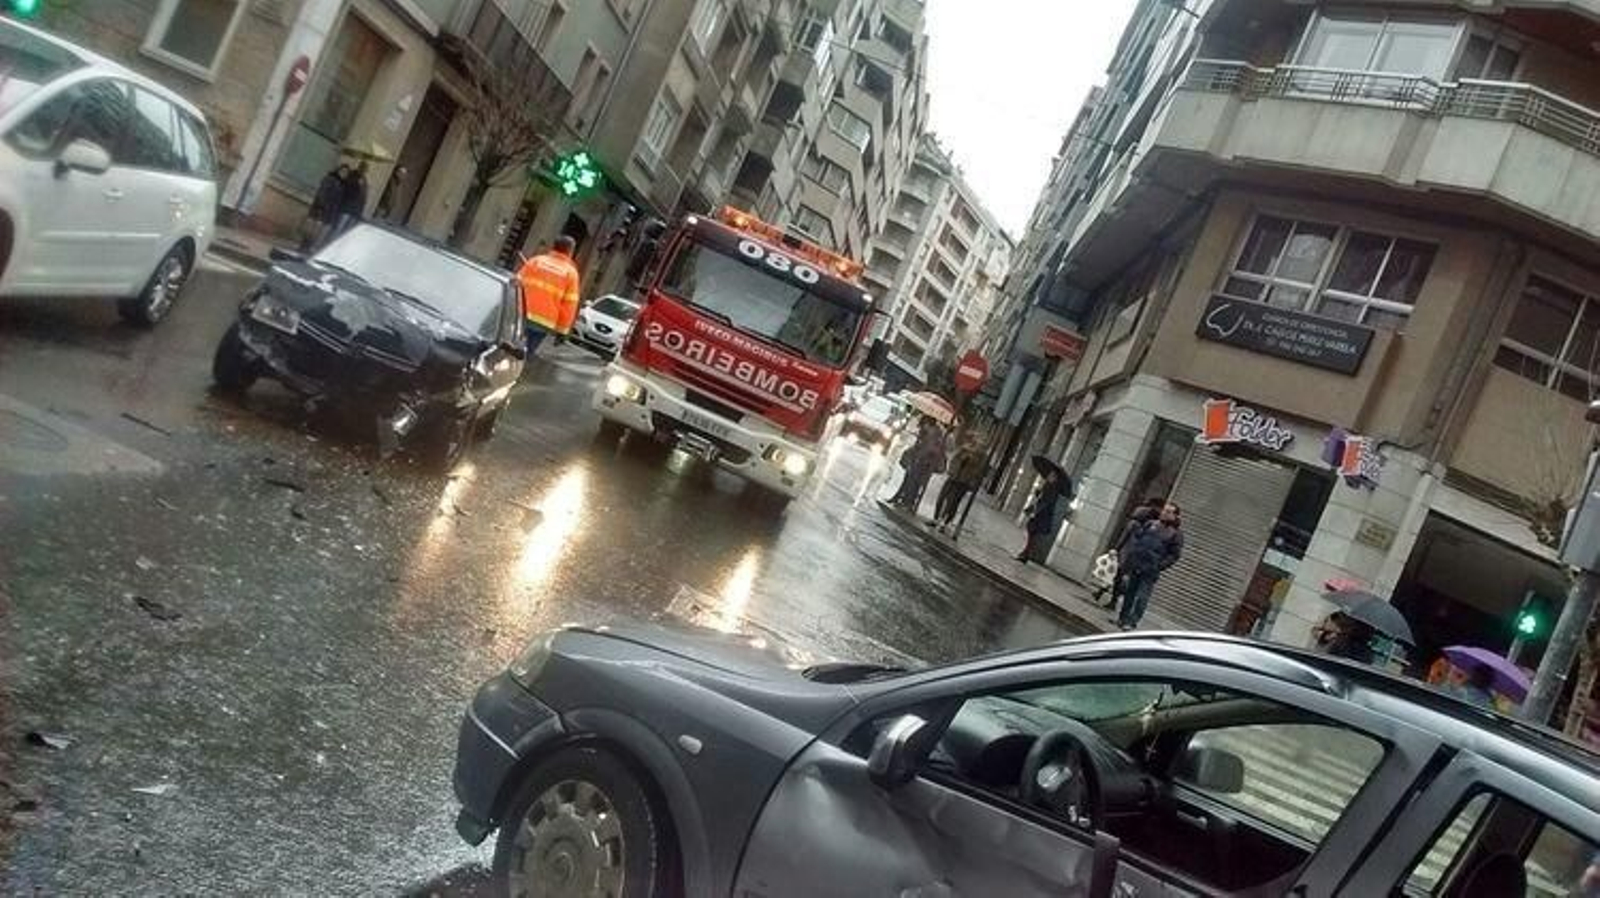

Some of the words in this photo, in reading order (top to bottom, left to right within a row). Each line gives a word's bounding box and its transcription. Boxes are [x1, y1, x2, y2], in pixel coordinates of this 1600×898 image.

[739, 239, 820, 285] 080
[694, 319, 732, 343] IVECO
[733, 334, 789, 367] MAGIRUS
